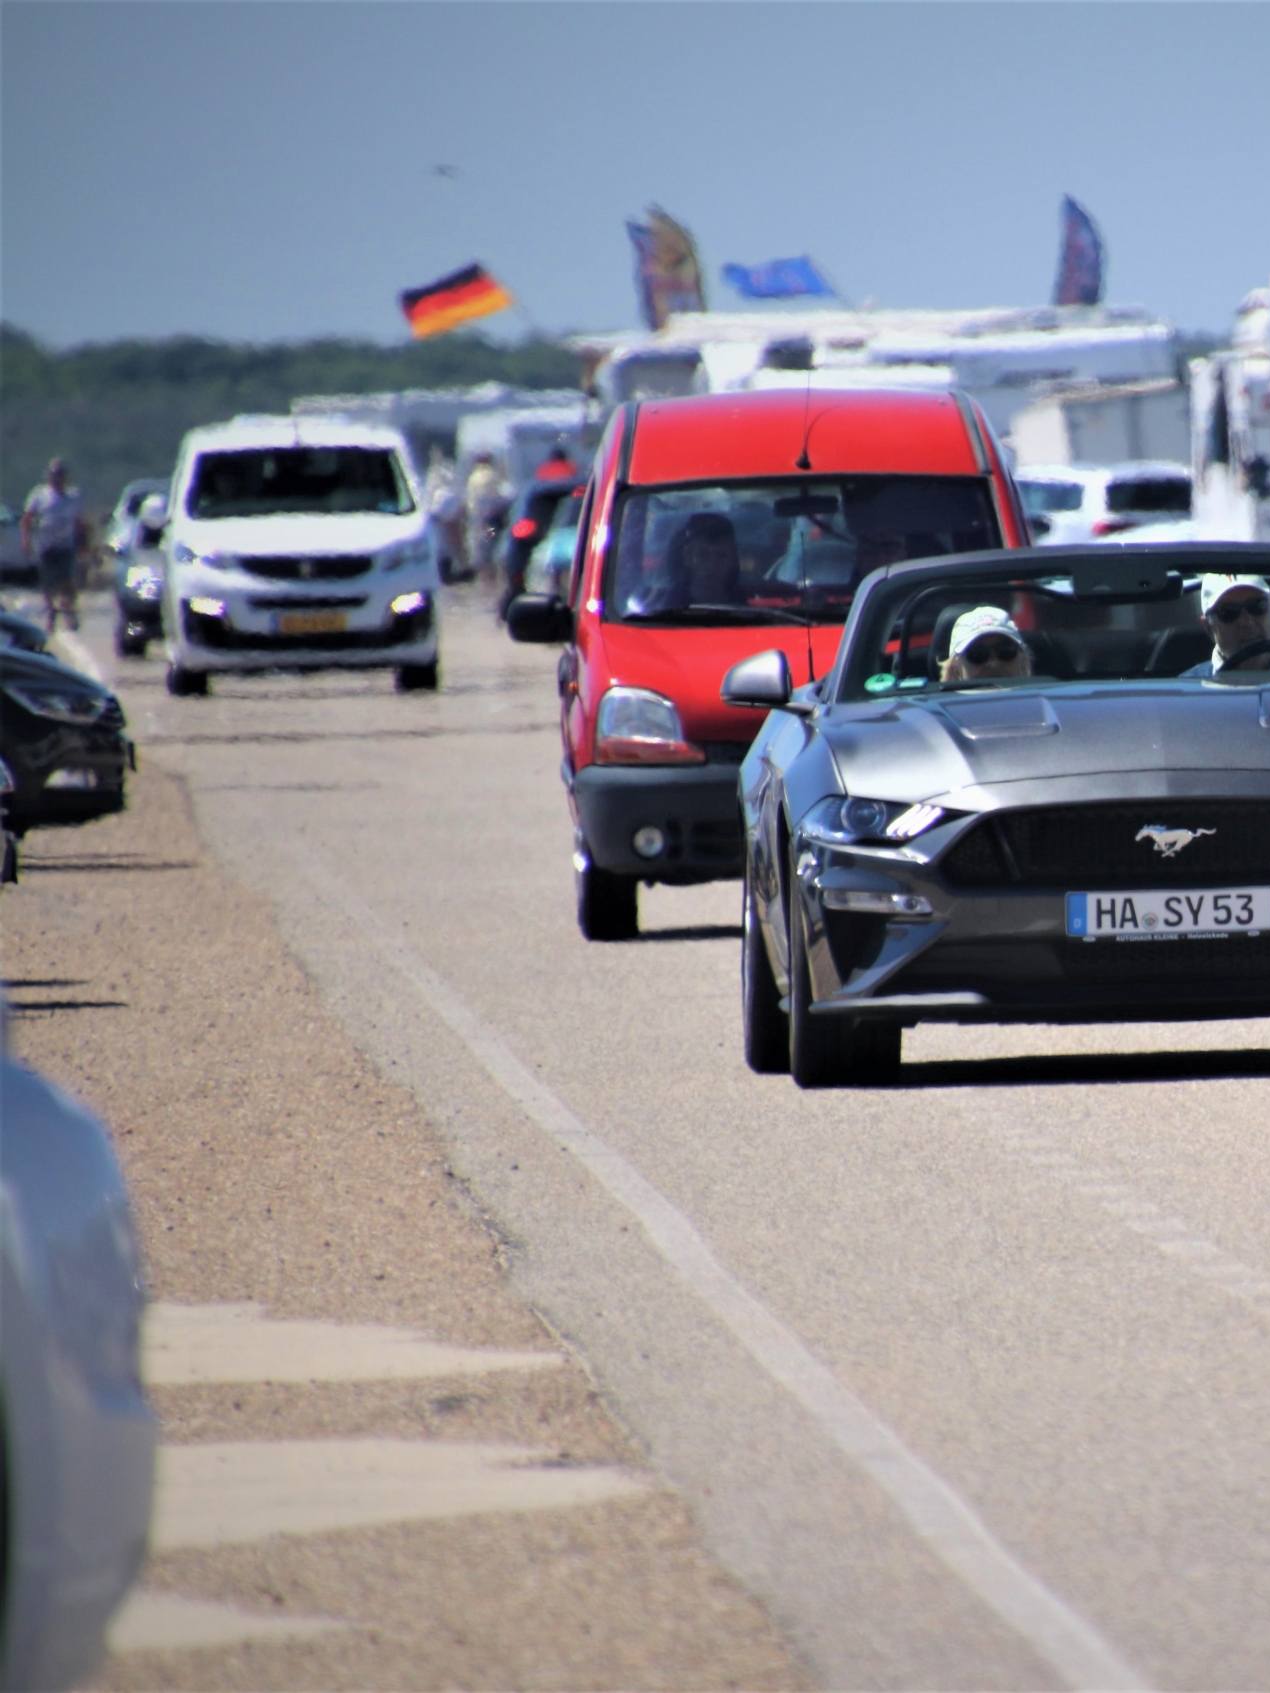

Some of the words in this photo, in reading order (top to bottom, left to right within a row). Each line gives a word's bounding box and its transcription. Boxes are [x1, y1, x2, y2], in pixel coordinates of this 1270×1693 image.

[1096, 897, 1139, 929] HA
[1163, 895, 1204, 928] SY
[1213, 894, 1254, 926] 53
[1115, 934, 1152, 942] AUTOHAUS
